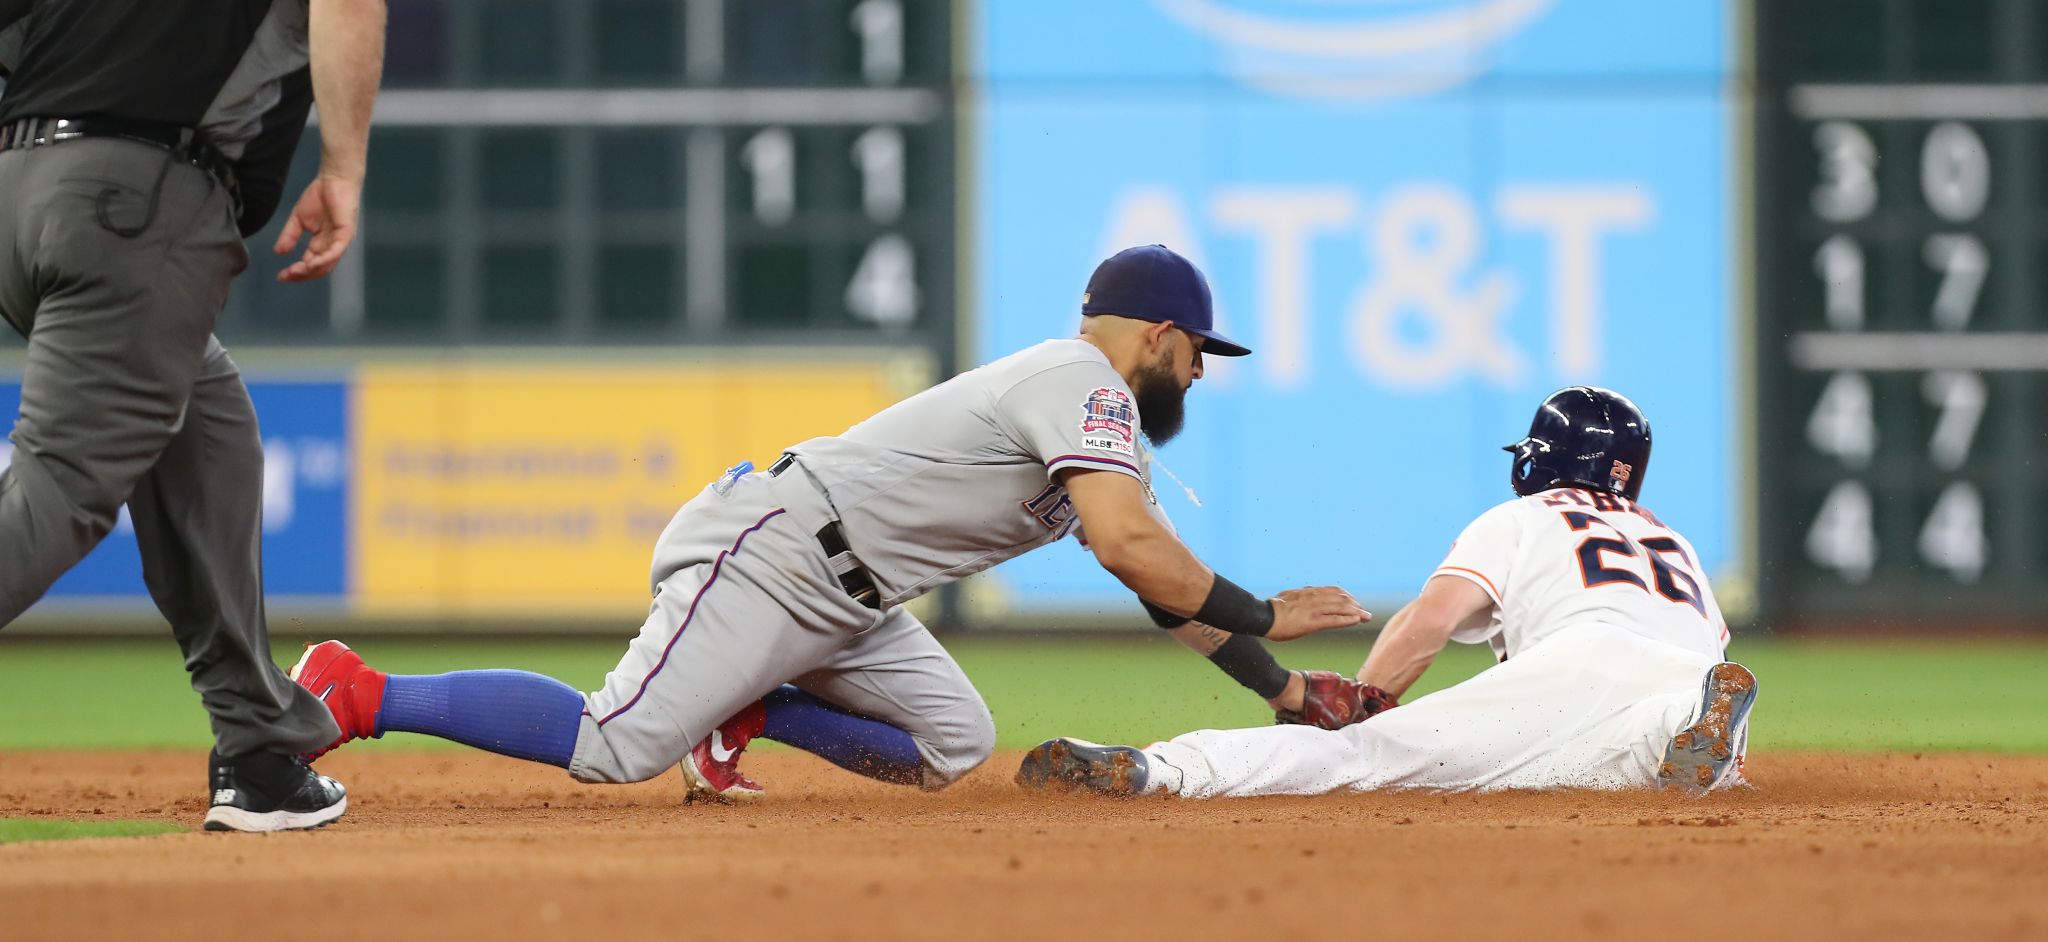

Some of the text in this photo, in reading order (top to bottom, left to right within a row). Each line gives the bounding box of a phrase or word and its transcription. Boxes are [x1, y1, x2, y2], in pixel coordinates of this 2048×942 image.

[742, 125, 906, 227] 1 1
[1811, 121, 1990, 222] 3 0
[846, 234, 920, 334] 4
[1814, 234, 1990, 332] 1 7
[1921, 370, 1988, 470] 7
[1610, 460, 1632, 482] 26
[1561, 511, 1708, 620] 26
[1807, 480, 1989, 584] 4 4
